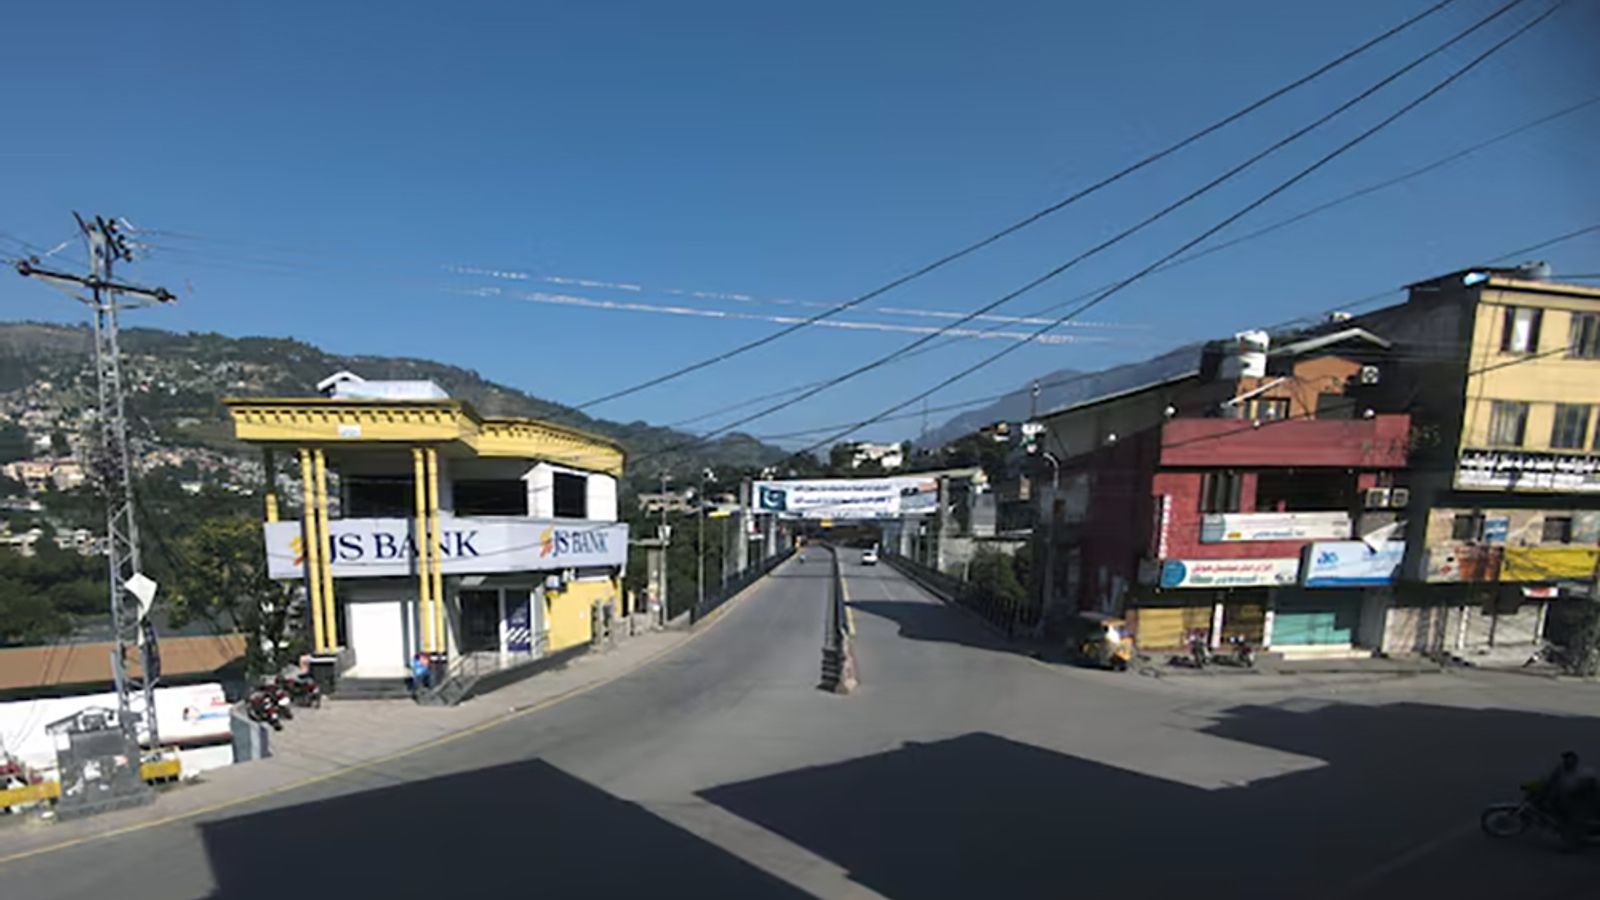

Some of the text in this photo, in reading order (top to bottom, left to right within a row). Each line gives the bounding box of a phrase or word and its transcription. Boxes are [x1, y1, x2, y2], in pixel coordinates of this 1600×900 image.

[329, 530, 479, 563] JS BANK
[553, 530, 608, 556] JS BANK
